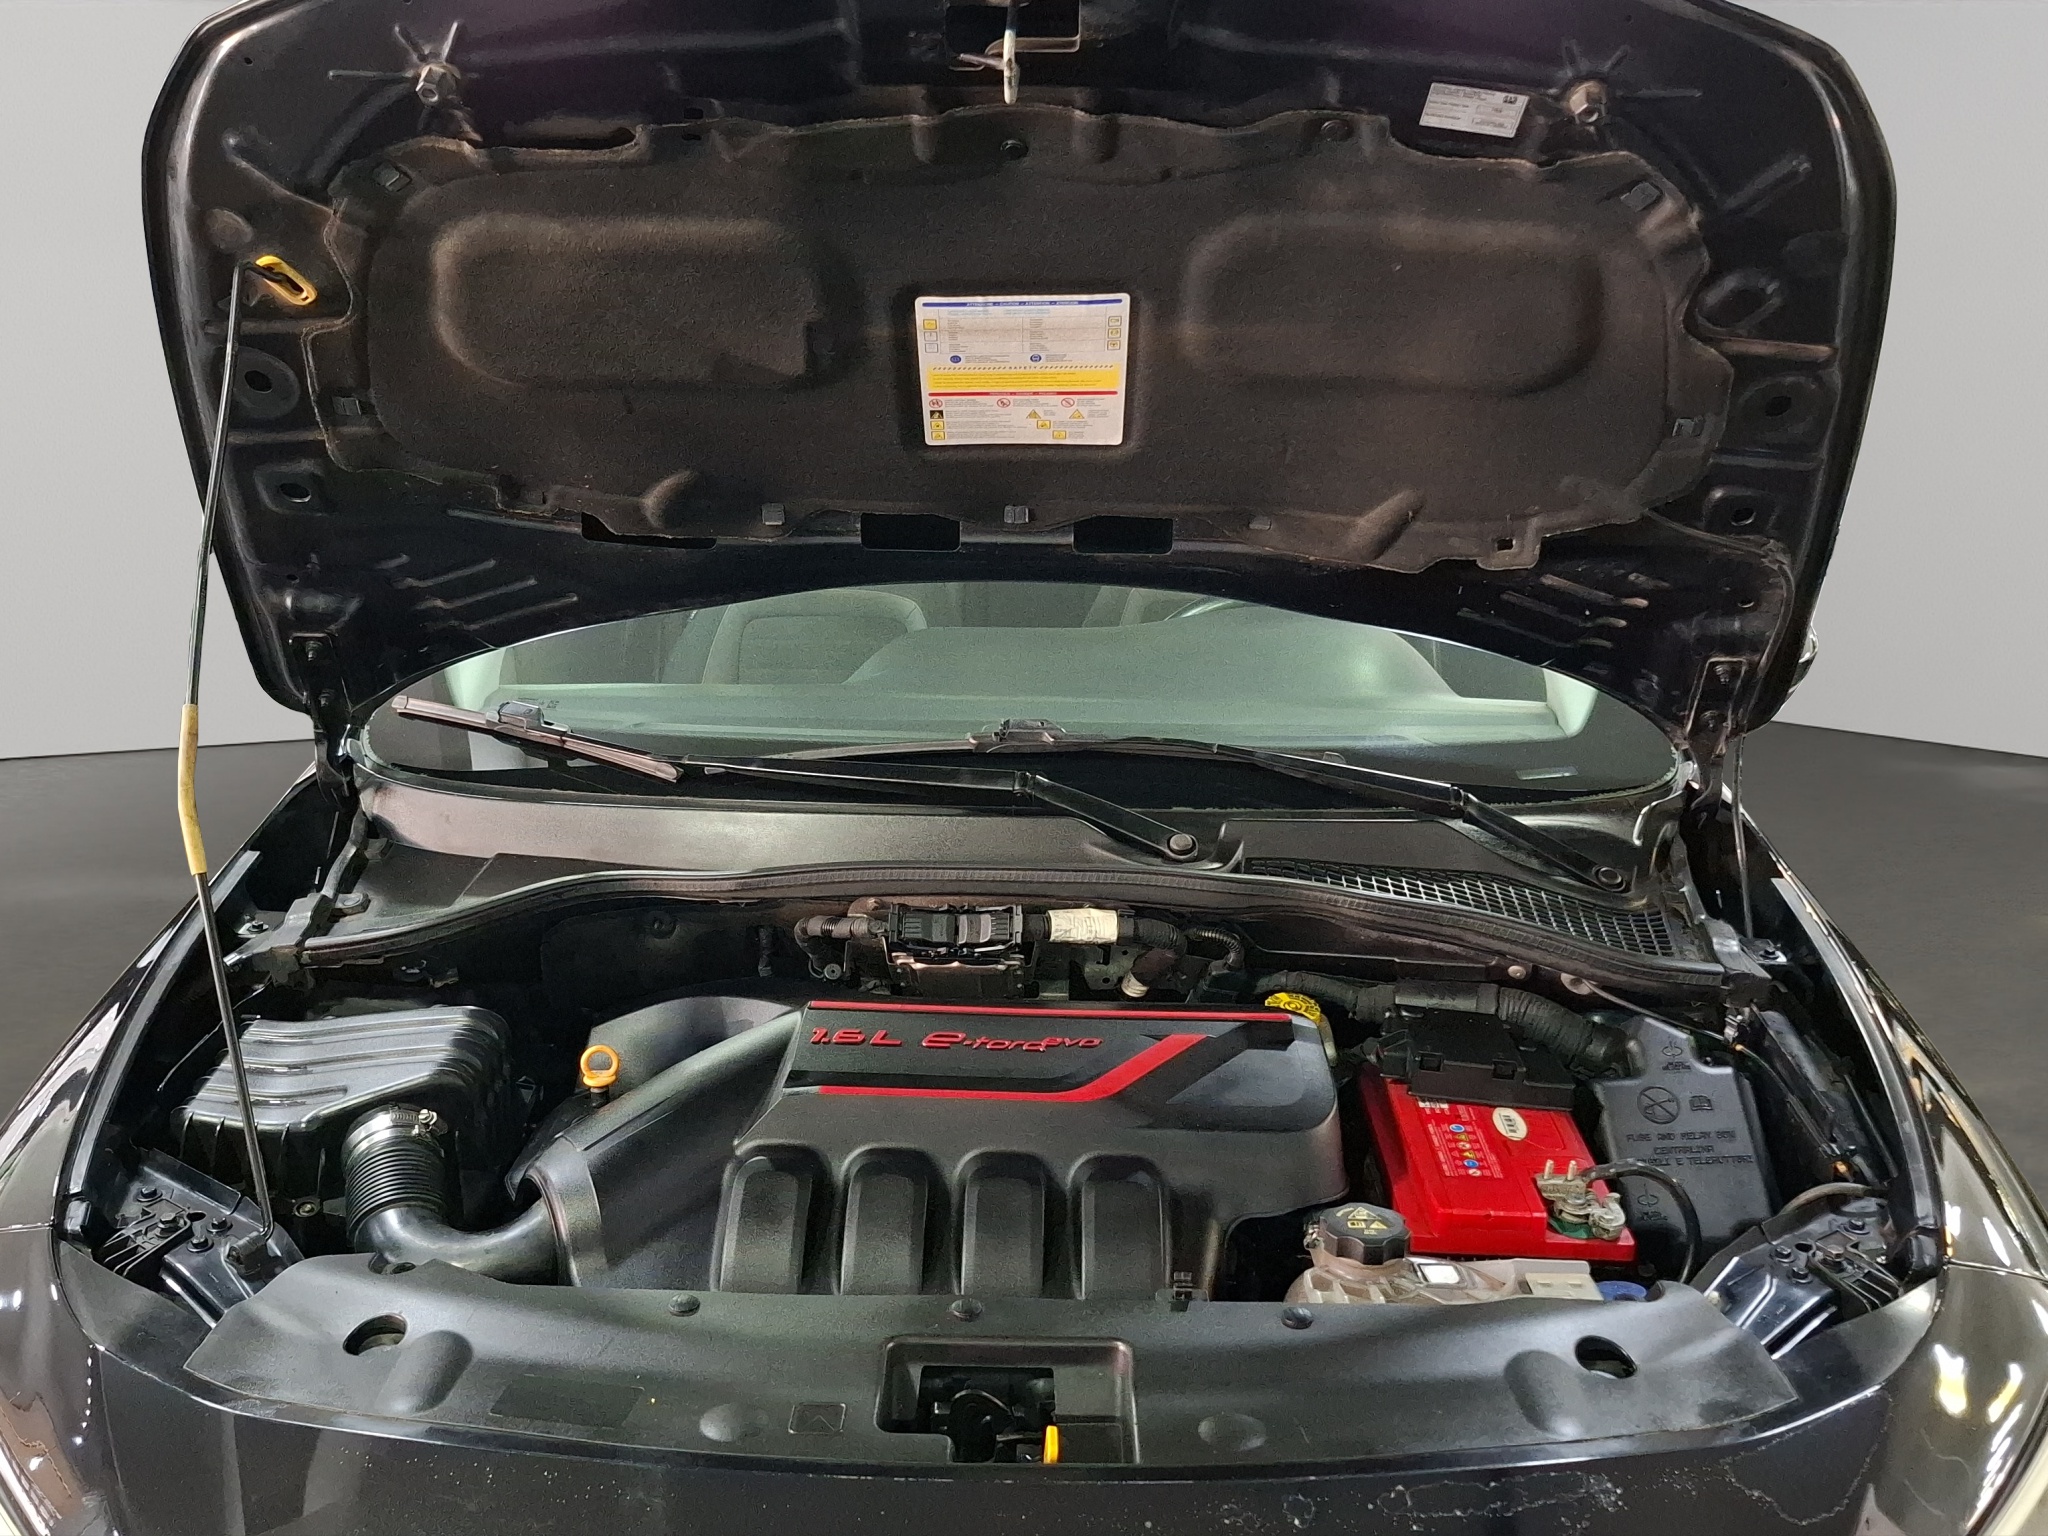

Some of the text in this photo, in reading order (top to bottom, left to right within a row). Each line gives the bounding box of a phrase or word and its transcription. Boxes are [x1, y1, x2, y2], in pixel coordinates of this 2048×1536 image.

[1626, 1133, 1652, 1142] FUSE
[1657, 1132, 1675, 1141] AND
[1681, 1131, 1713, 1141] RELAY
